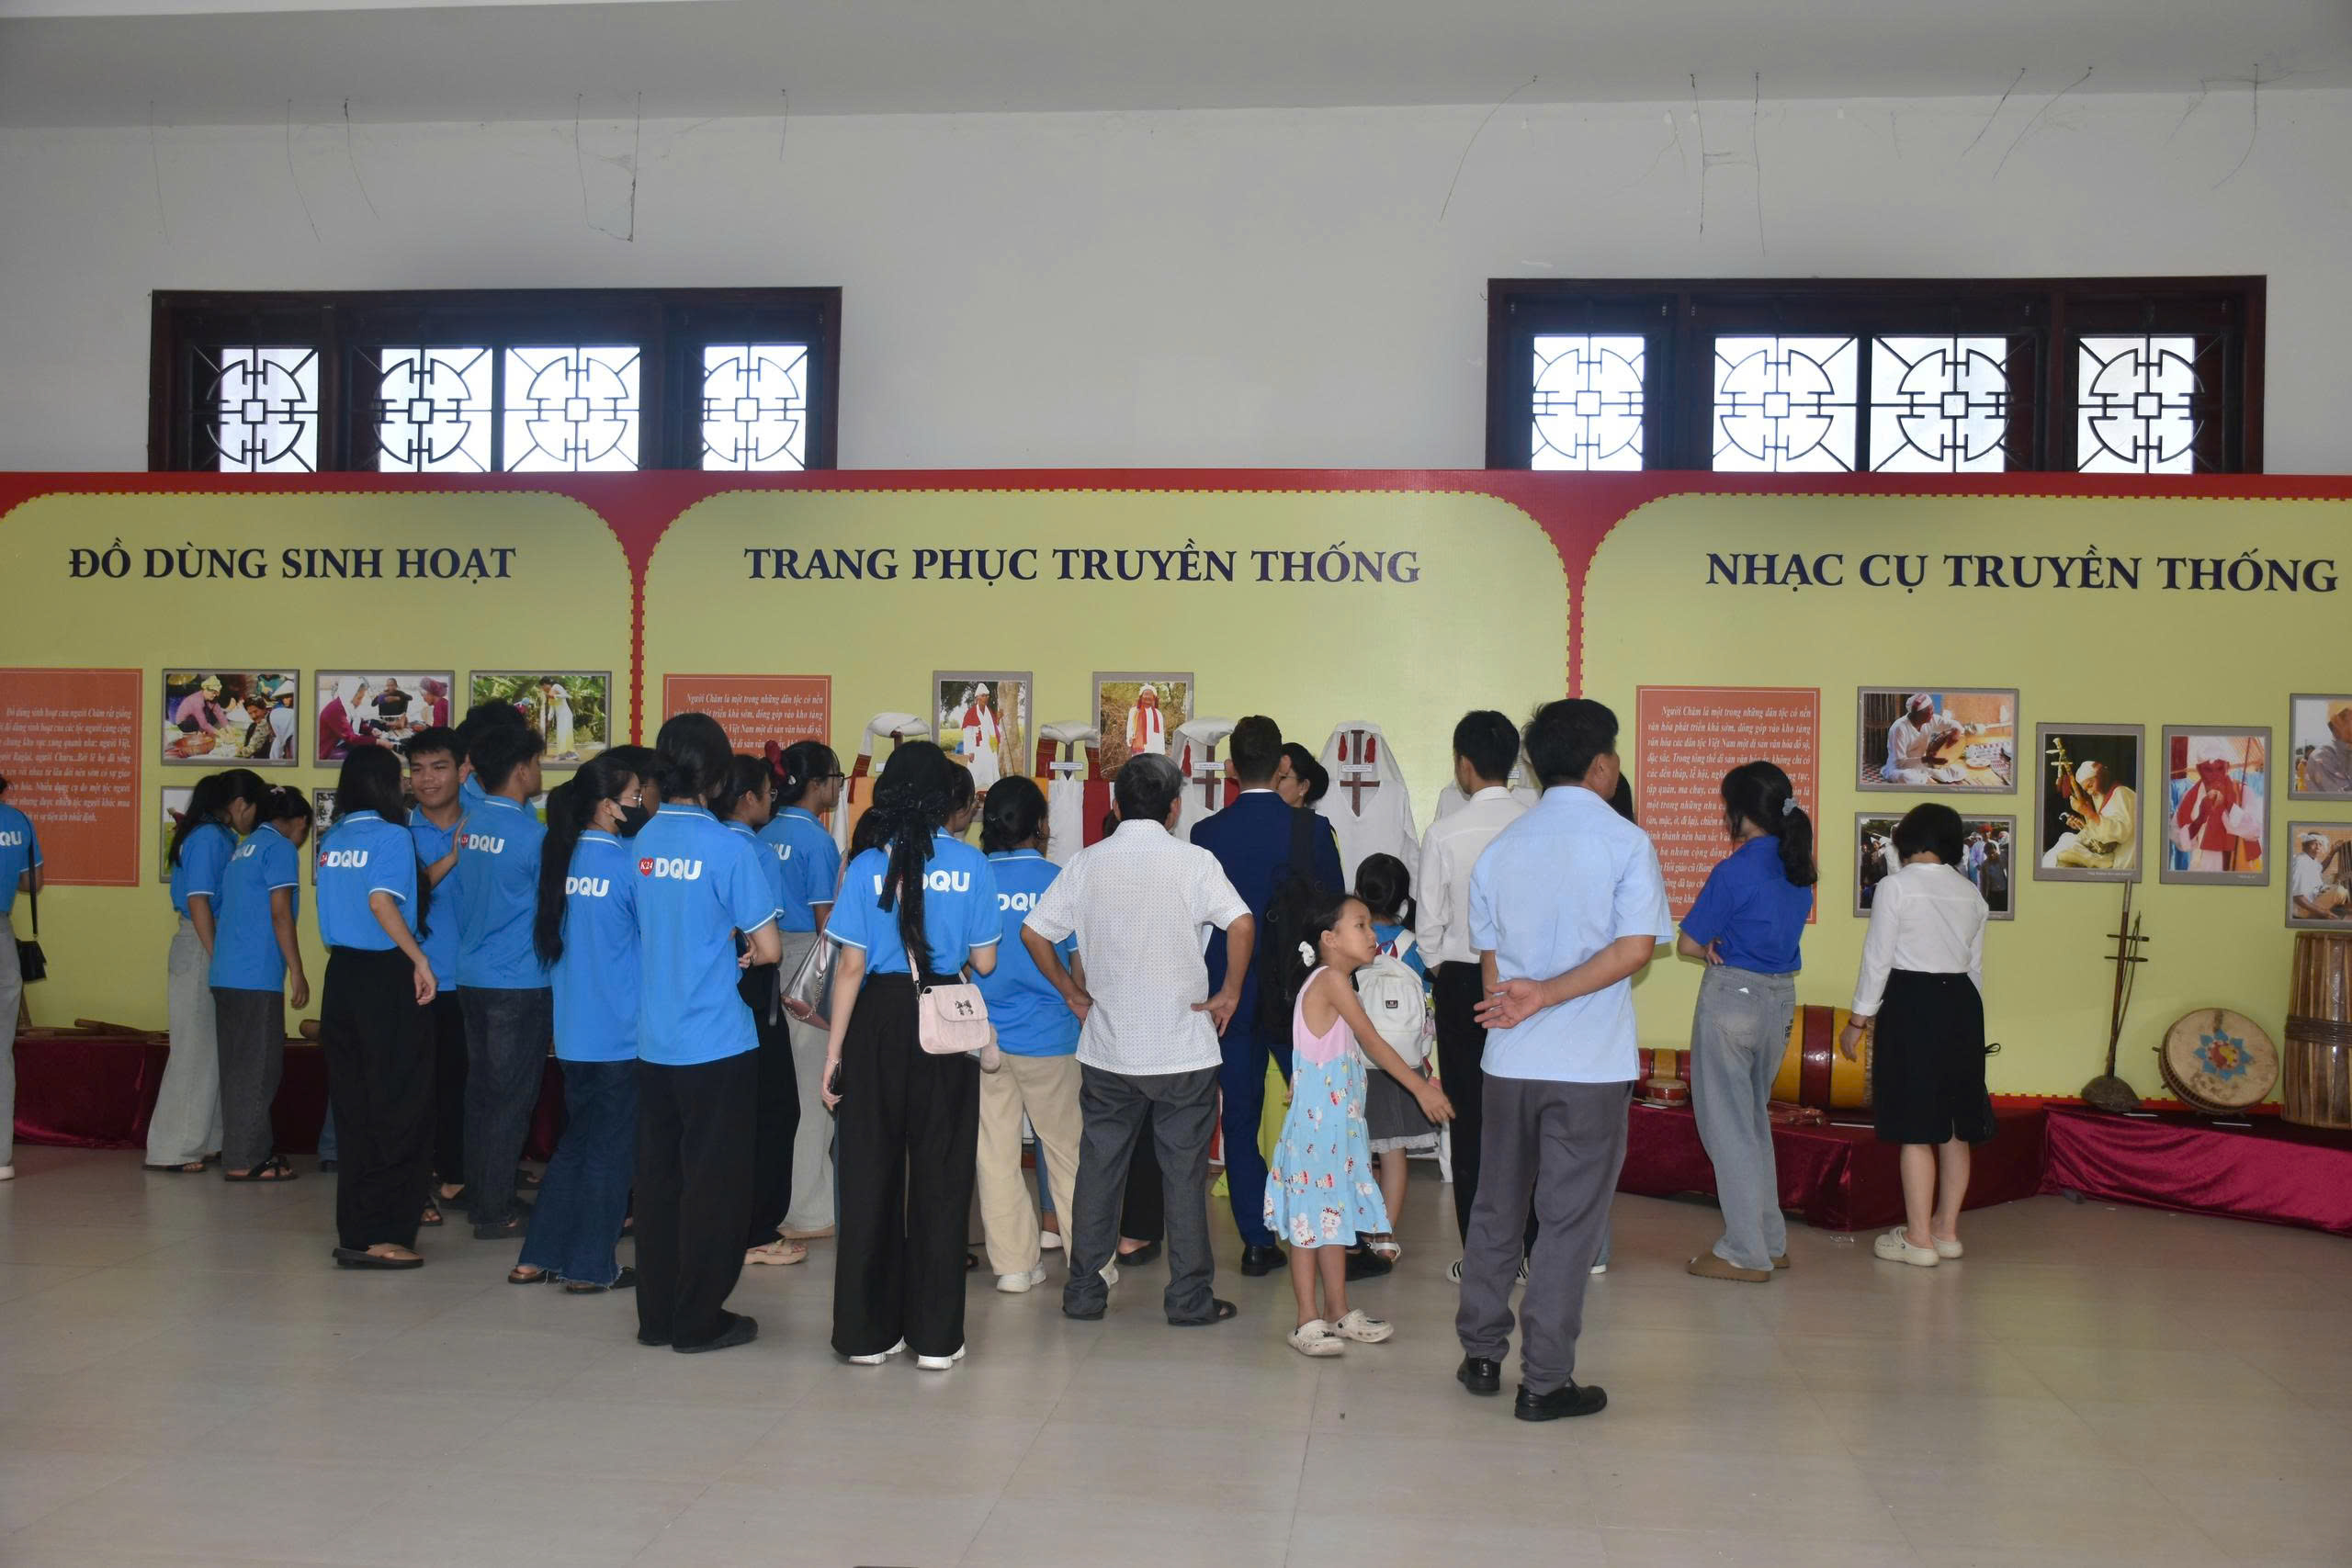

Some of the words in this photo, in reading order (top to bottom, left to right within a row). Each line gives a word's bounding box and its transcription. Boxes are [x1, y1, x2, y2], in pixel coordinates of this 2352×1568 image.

[68, 536, 131, 579] ĐỒ
[142, 541, 268, 580] DÙNG
[281, 547, 384, 579] SINH
[396, 547, 516, 585] HOẠT
[743, 547, 899, 581] TRANG
[911, 548, 1037, 587] PHỤC
[1052, 537, 1237, 582] TRUYỀN
[1250, 540, 1419, 582] THỐNG
[1705, 553, 1844, 592] NHẠC
[1859, 554, 1928, 594] CỤ
[1942, 544, 2143, 590] TRUYỀN
[2156, 547, 2338, 592] THỐNG
[743, 695, 759, 705] trong
[1683, 706, 1701, 716] Chăm
[1702, 707, 1709, 716] là
[1711, 707, 1723, 718] một
[1724, 708, 1741, 719] trong
[1743, 707, 1764, 719] những
[1765, 708, 1777, 716] dân
[1778, 708, 1788, 719] tộc
[1790, 708, 1797, 717] có
[1781, 724, 1793, 733] kho
[1722, 739, 1736, 748] Nam
[1673, 753, 1690, 764] Trong
[469, 834, 504, 853] DQU
[327, 850, 368, 867] DQU
[655, 858, 702, 880] DQU
[565, 876, 609, 897] DQU
[923, 870, 971, 893] QU
